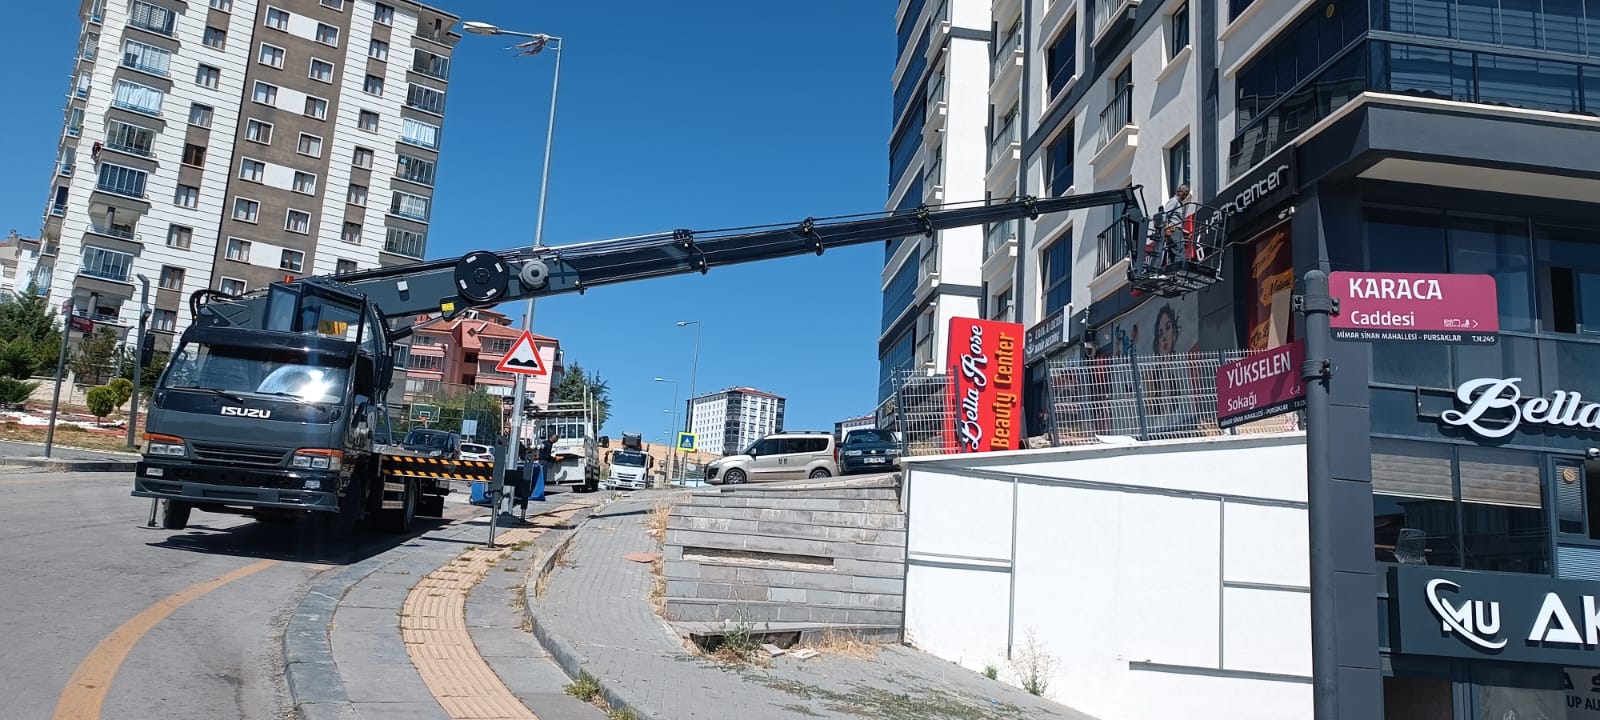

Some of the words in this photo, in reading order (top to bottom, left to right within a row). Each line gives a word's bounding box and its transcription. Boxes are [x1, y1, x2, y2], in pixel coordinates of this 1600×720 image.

[1350, 278, 1443, 300] KARACA
[1336, 330, 1360, 339] MİMAR
[1361, 331, 1381, 339] SİNAN
[1381, 332, 1418, 341] MAHALLESİ
[1423, 334, 1462, 342] PURSAKLAR
[1351, 311, 1415, 326] Caddesi
[961, 325, 988, 387] Rose
[994, 331, 1015, 384] Center
[1226, 351, 1291, 389] YÜKSELEN
[221, 406, 271, 419] ISUZU
[961, 388, 982, 450] Bella
[991, 392, 1017, 448] Beauty
[1228, 392, 1257, 412] Sokağı
[1441, 377, 1600, 438] Bella
